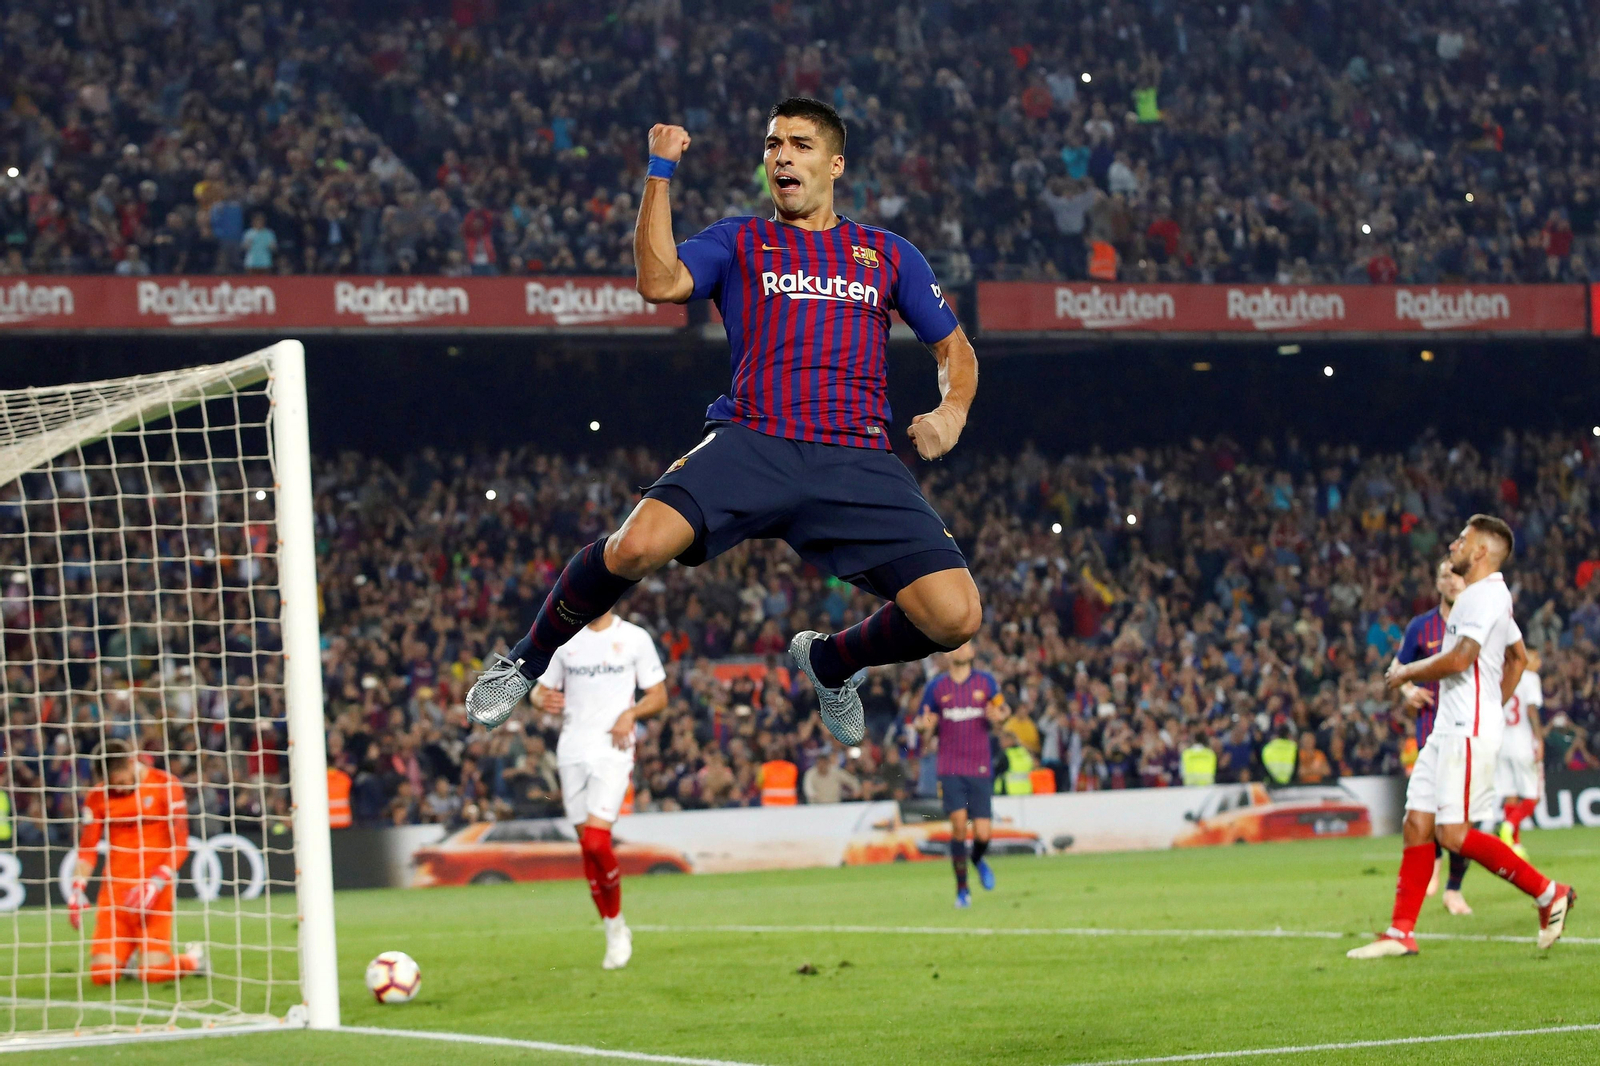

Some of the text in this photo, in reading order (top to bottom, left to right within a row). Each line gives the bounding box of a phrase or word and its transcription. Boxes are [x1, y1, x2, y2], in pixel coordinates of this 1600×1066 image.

[136, 280, 277, 316] Rakuten
[333, 280, 469, 315] Rakuten
[762, 270, 878, 307] Rakuten
[1054, 284, 1176, 319] Rakuten
[1226, 286, 1346, 320] Rakuten
[1395, 286, 1511, 320] Rakuten
